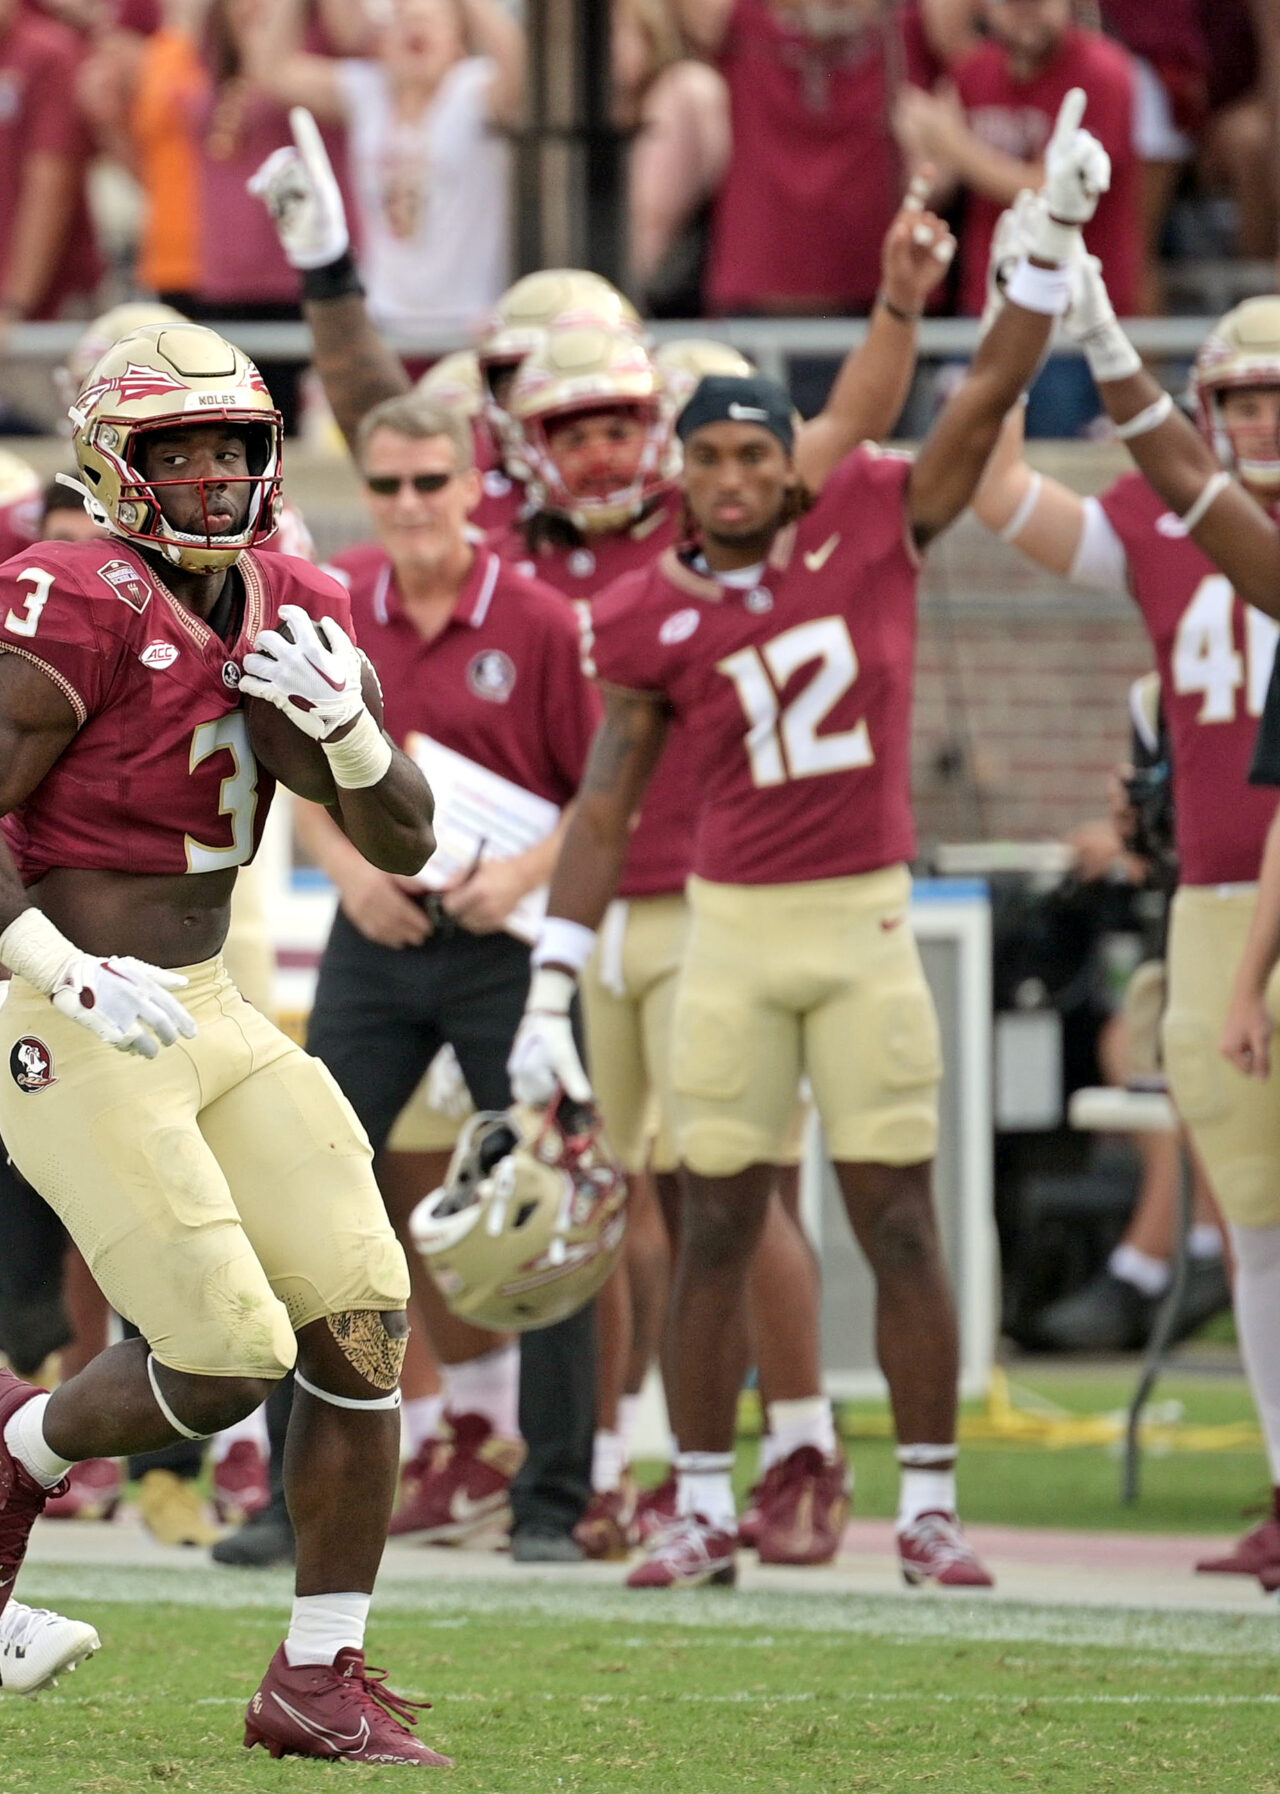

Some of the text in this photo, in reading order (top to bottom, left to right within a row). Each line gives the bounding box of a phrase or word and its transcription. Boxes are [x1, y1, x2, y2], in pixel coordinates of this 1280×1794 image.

[198, 395, 236, 405] NOLES
[4, 567, 56, 637] 3
[147, 646, 173, 660] ACC
[716, 614, 875, 788] 12
[184, 708, 259, 874] 3
